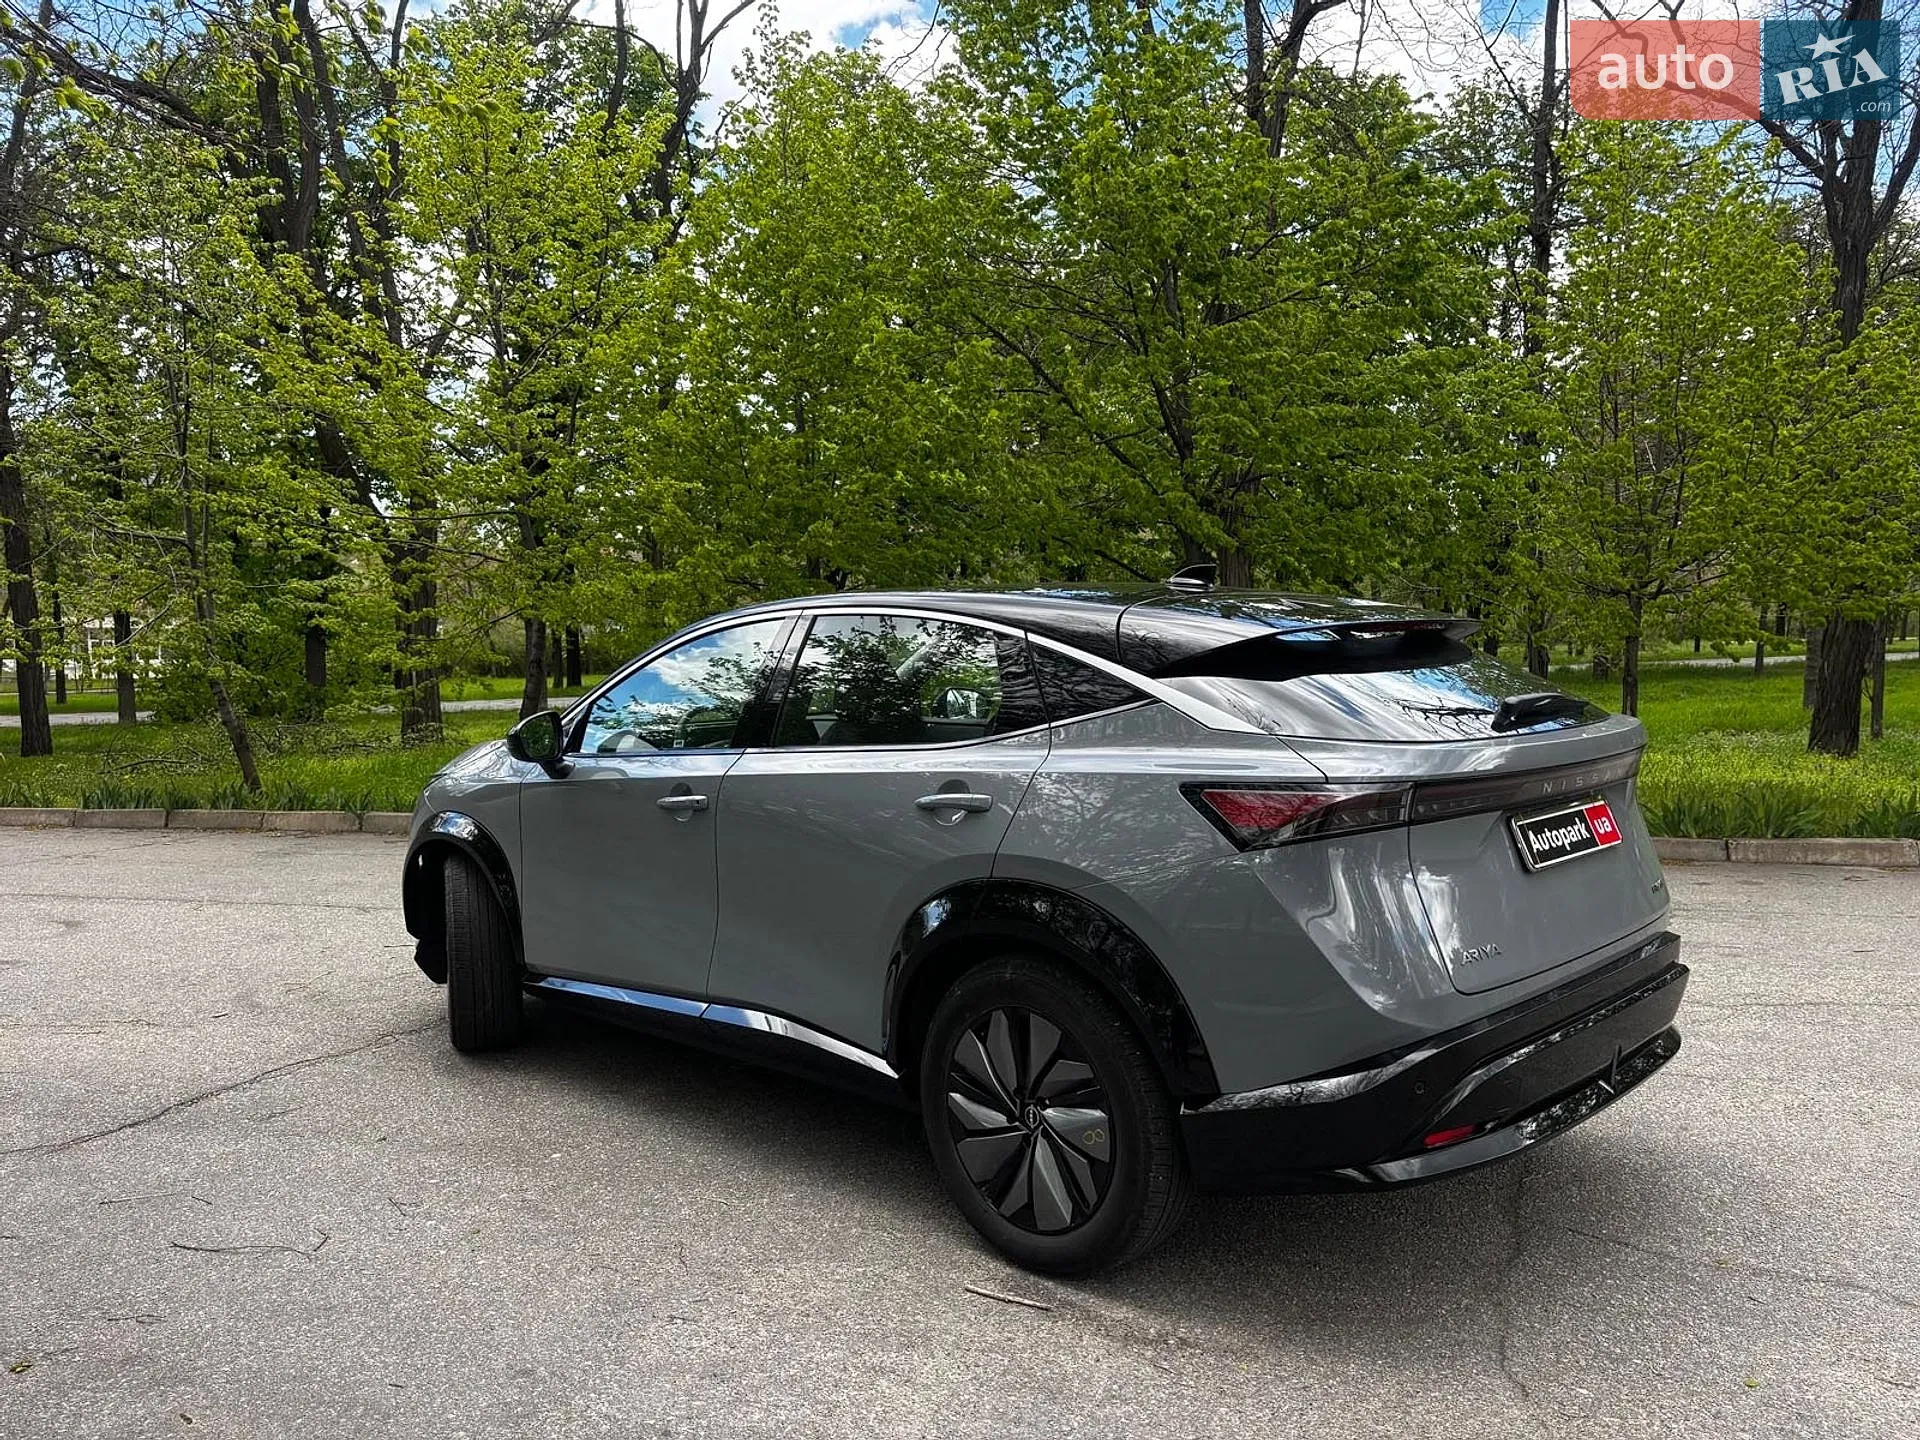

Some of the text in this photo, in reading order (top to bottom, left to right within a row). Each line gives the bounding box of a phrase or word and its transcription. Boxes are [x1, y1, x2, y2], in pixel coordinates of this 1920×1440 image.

[1528, 816, 1612, 853] Autopark ua
[1461, 943, 1503, 966] ARIYA
